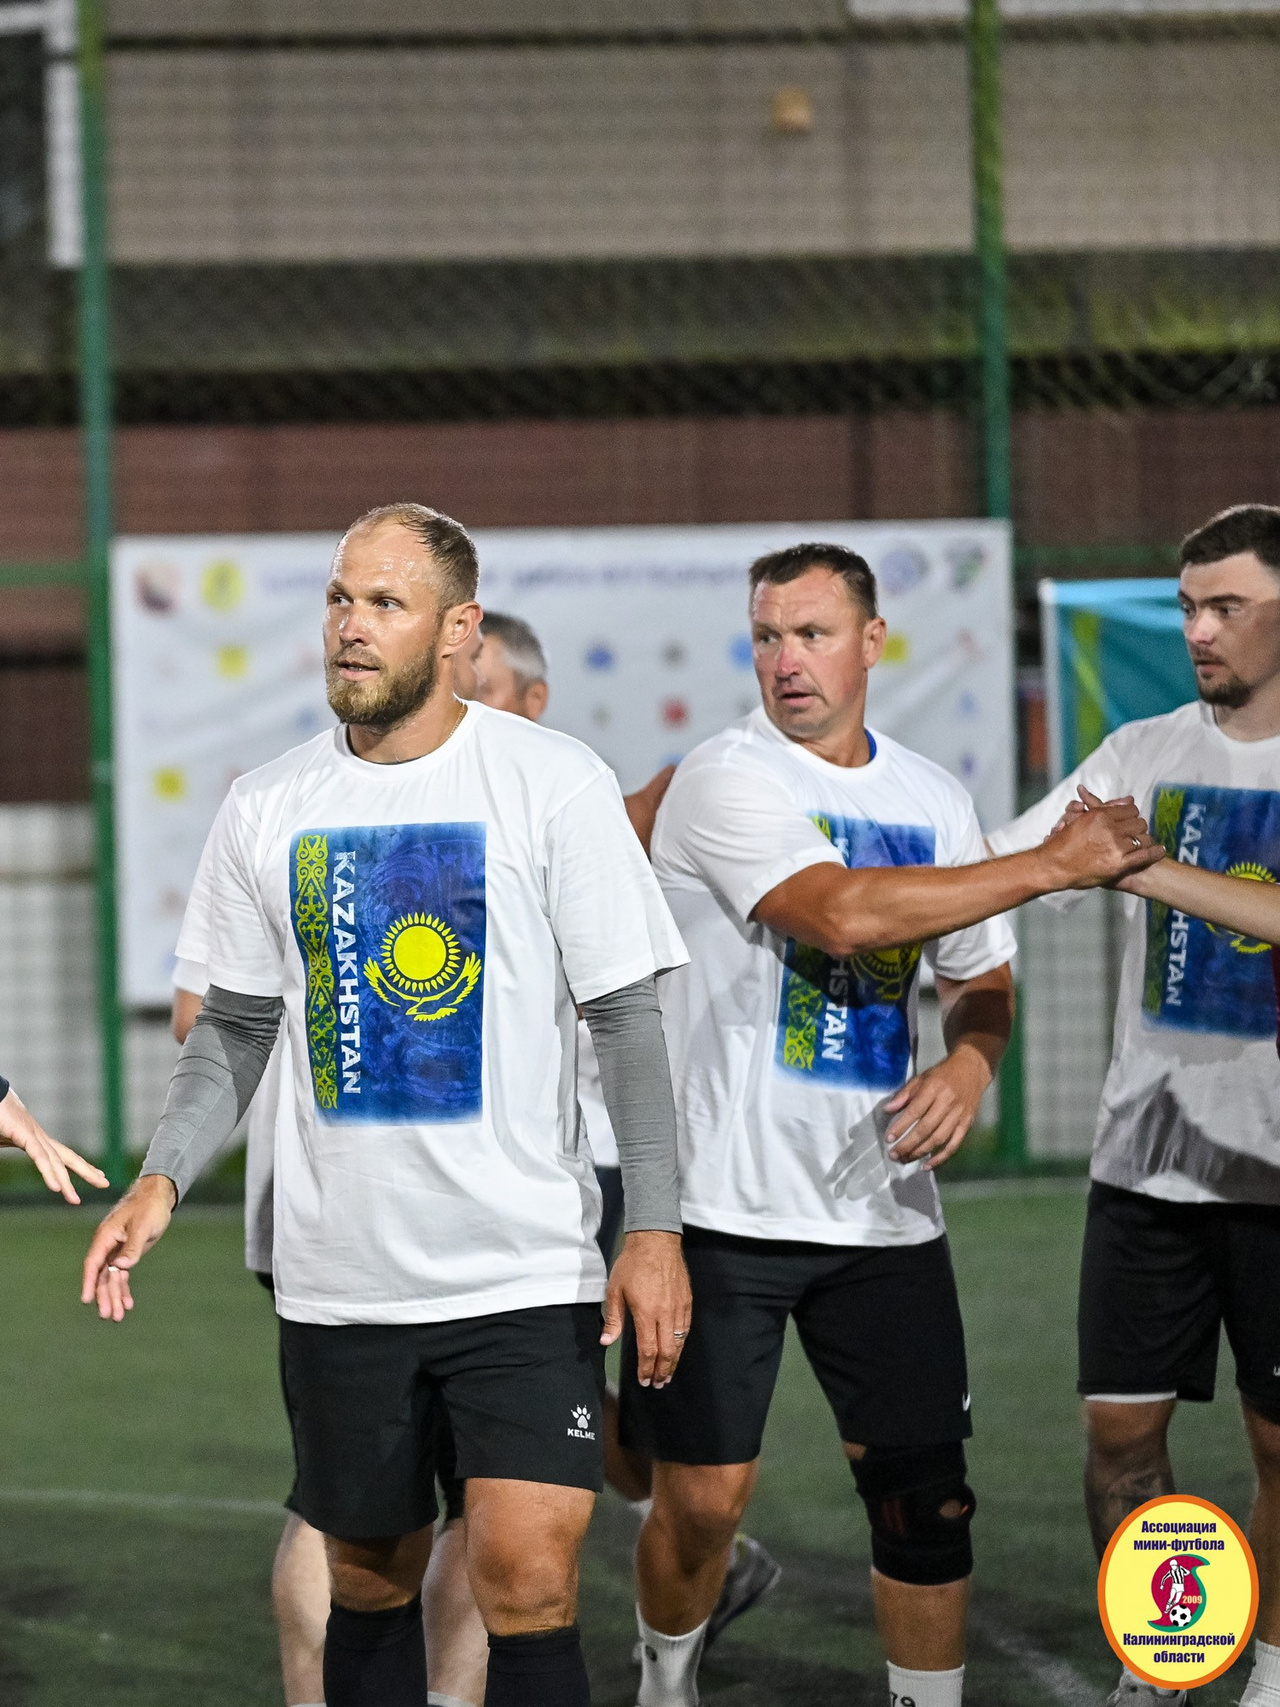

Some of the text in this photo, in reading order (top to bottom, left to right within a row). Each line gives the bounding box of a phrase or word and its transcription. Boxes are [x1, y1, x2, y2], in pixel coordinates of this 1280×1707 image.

[332, 850, 362, 1094] KAZAKHSTAN
[1166, 803, 1206, 1008] KAZHSTAN
[567, 1428, 596, 1440] KELME
